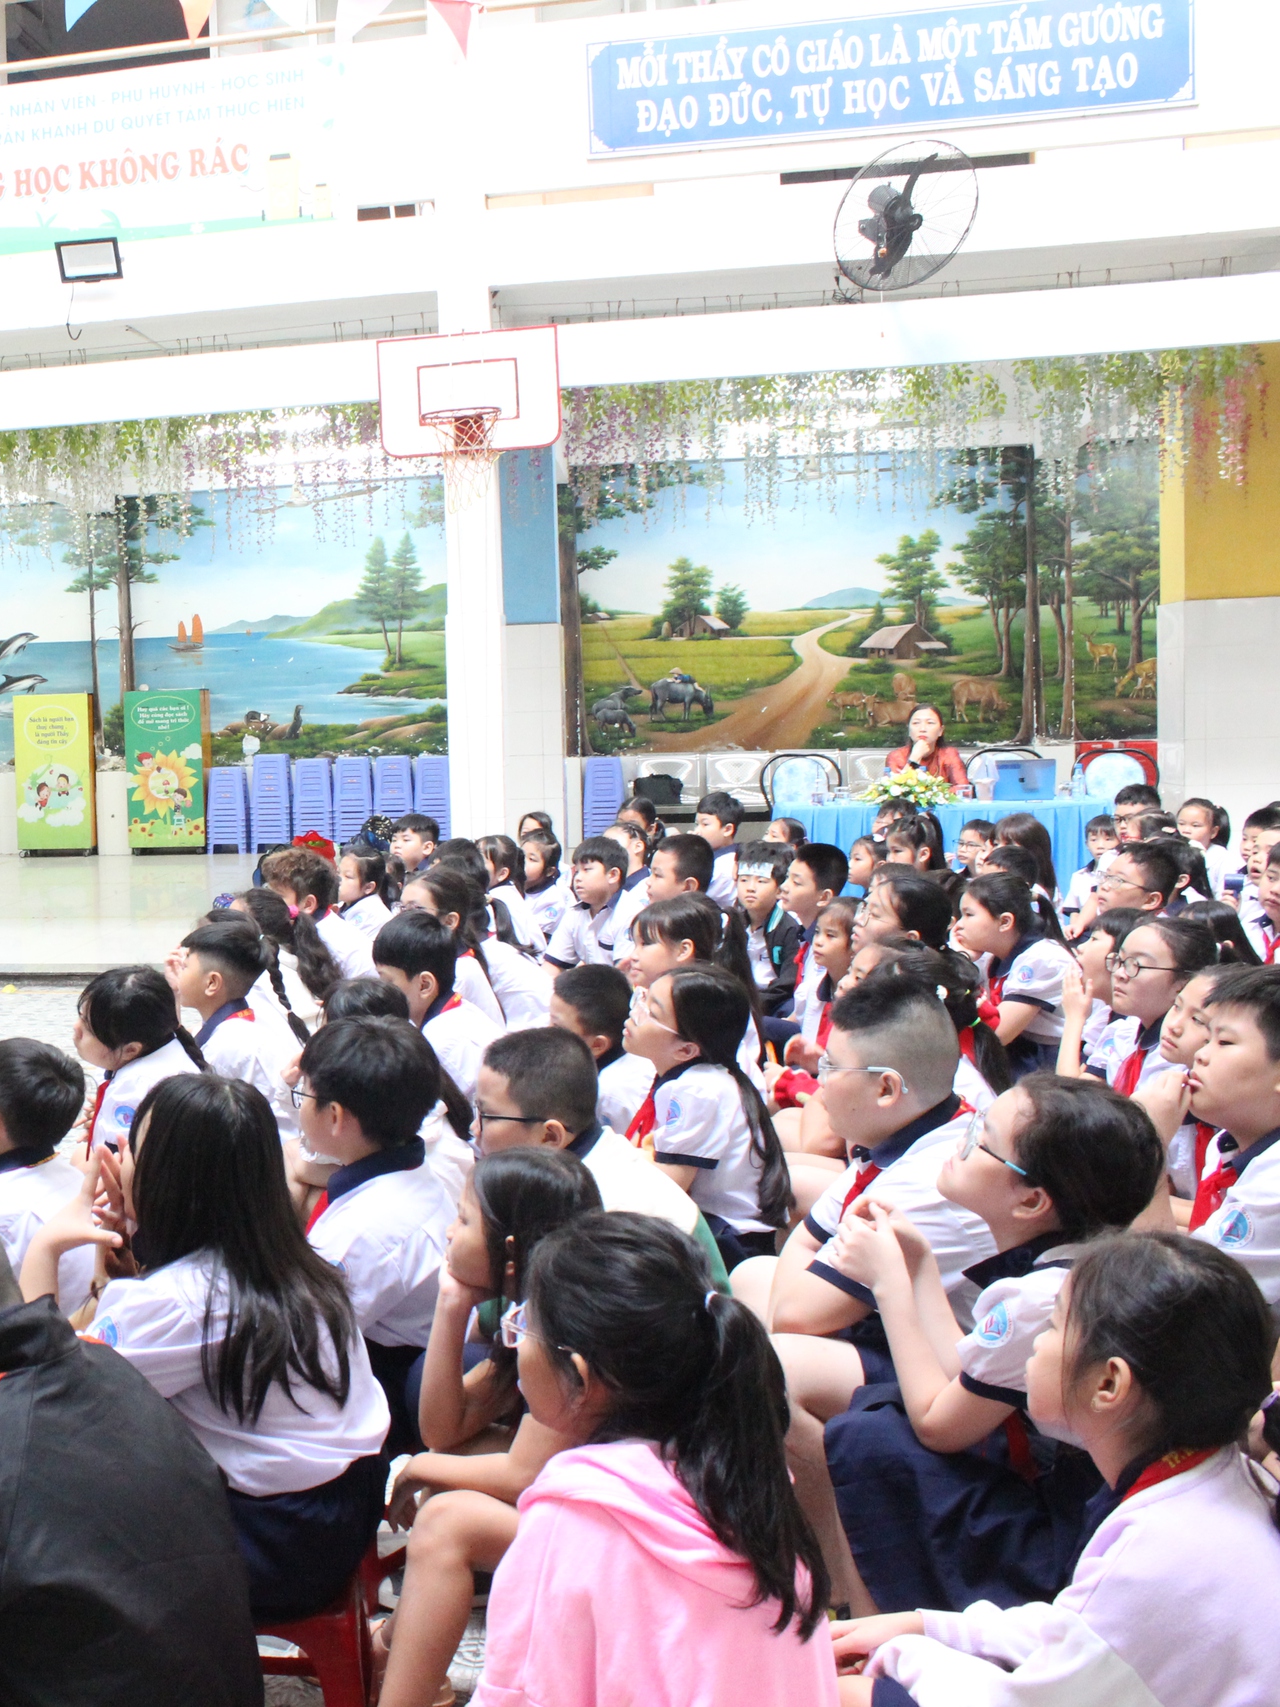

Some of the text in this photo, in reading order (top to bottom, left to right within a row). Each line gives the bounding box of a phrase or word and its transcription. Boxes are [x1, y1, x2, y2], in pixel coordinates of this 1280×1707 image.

[617, 2, 1165, 89] MỖI THẦY CÔ GIÁO LÀ MỘT TẤM GƯƠNG
[636, 52, 1138, 137] ĐẠO ĐỨC, TỰ HỌC VÀ SÁNG TẠO
[14, 164, 71, 203] HỌC
[78, 147, 181, 191] KHÔNG
[188, 136, 249, 178] RÁC
